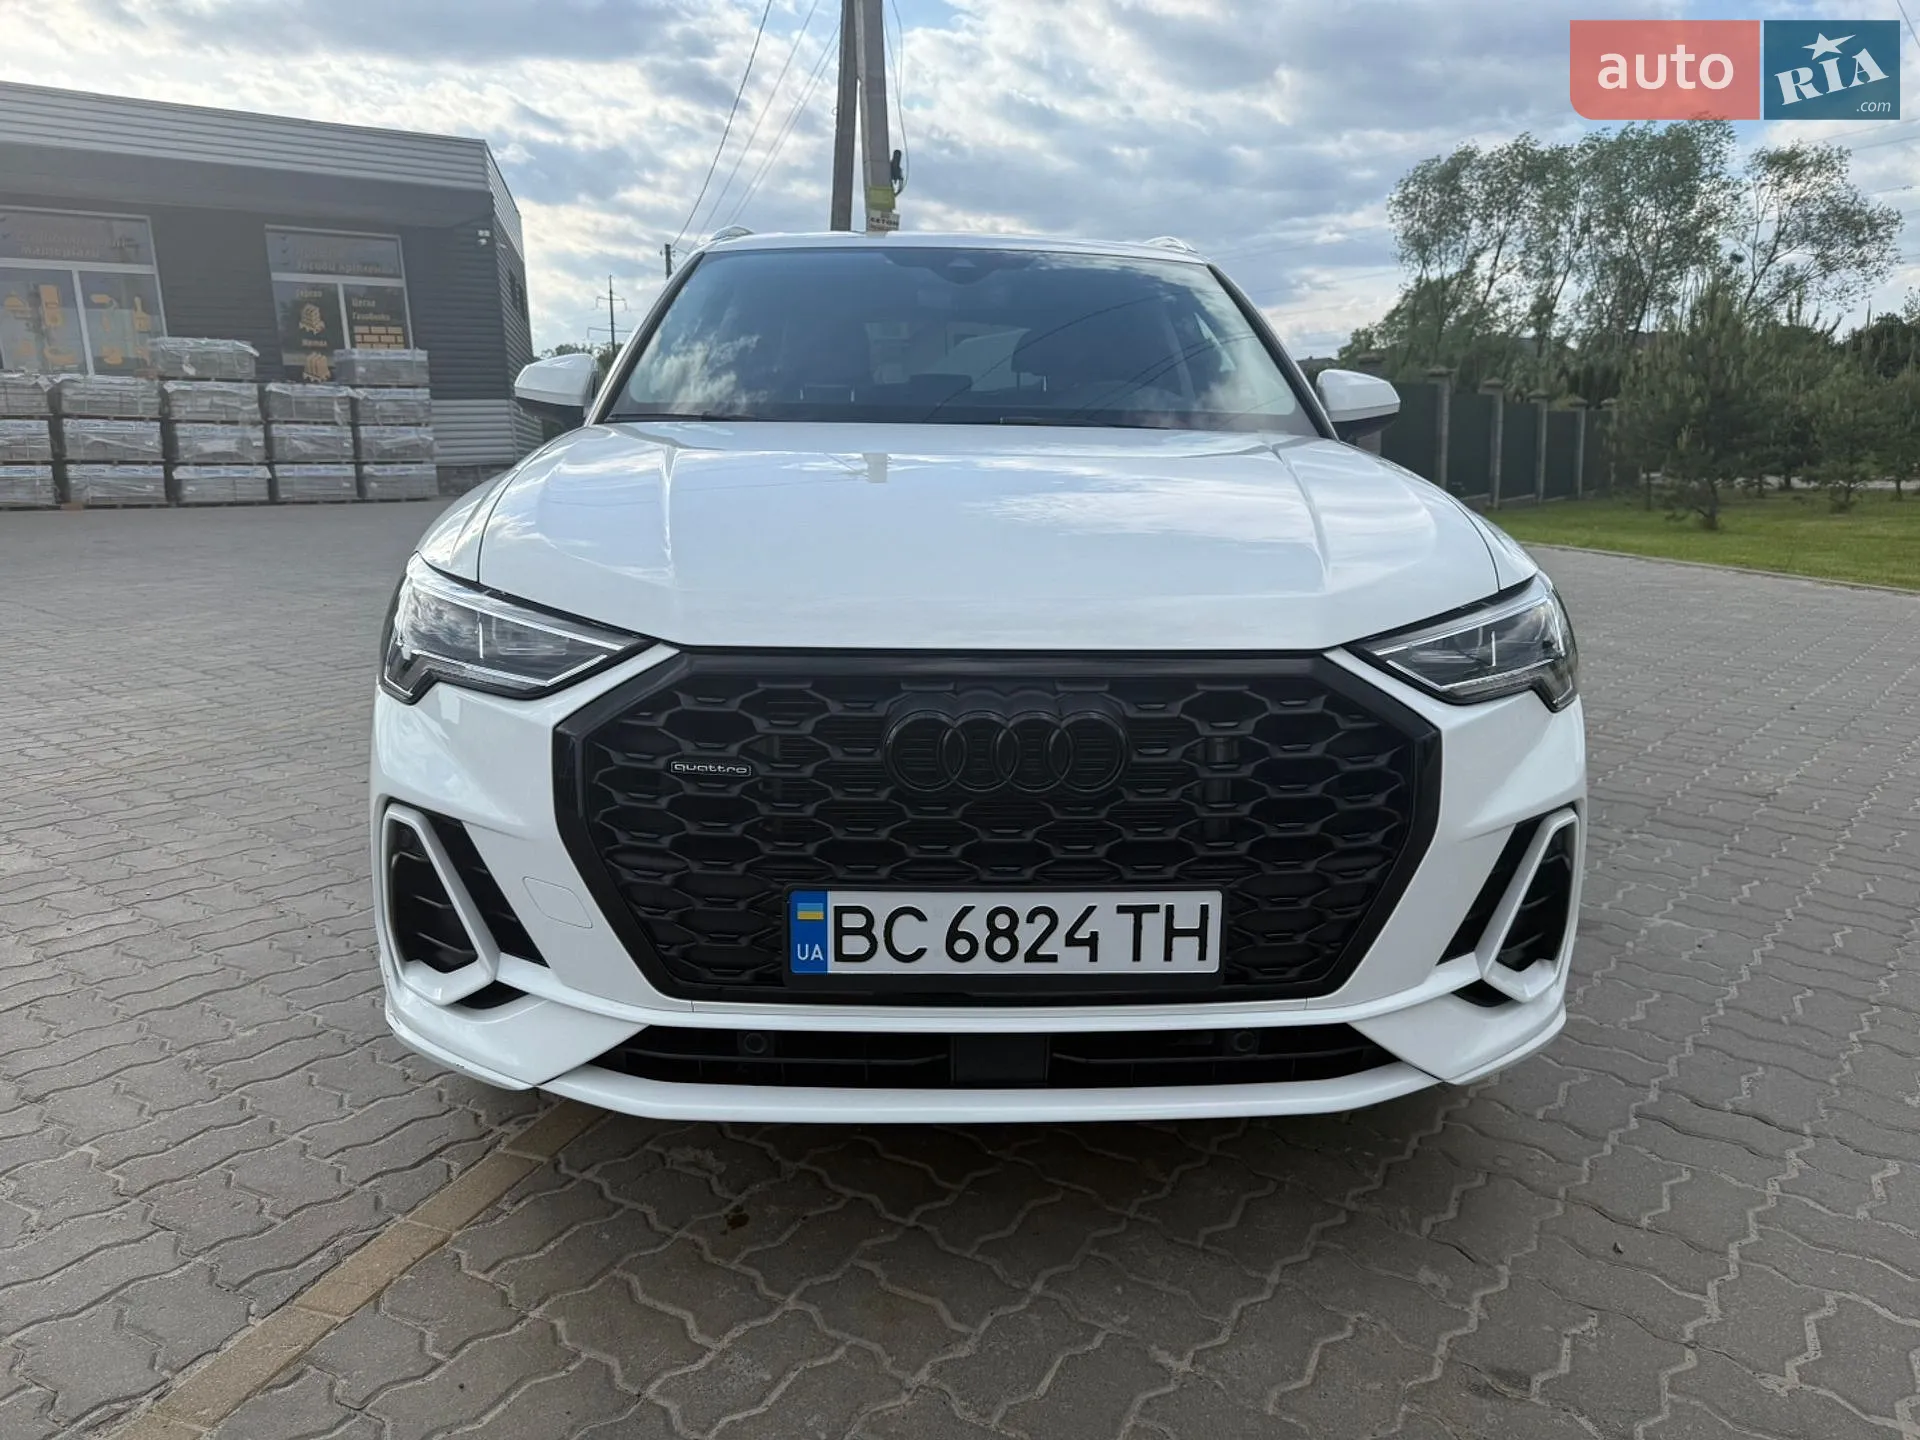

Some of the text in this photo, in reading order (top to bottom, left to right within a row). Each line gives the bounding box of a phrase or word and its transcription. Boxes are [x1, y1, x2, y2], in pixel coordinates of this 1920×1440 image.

[674, 763, 748, 774] quattro
[833, 903, 1210, 963] BC 6824 TH
[797, 943, 825, 962] UA
